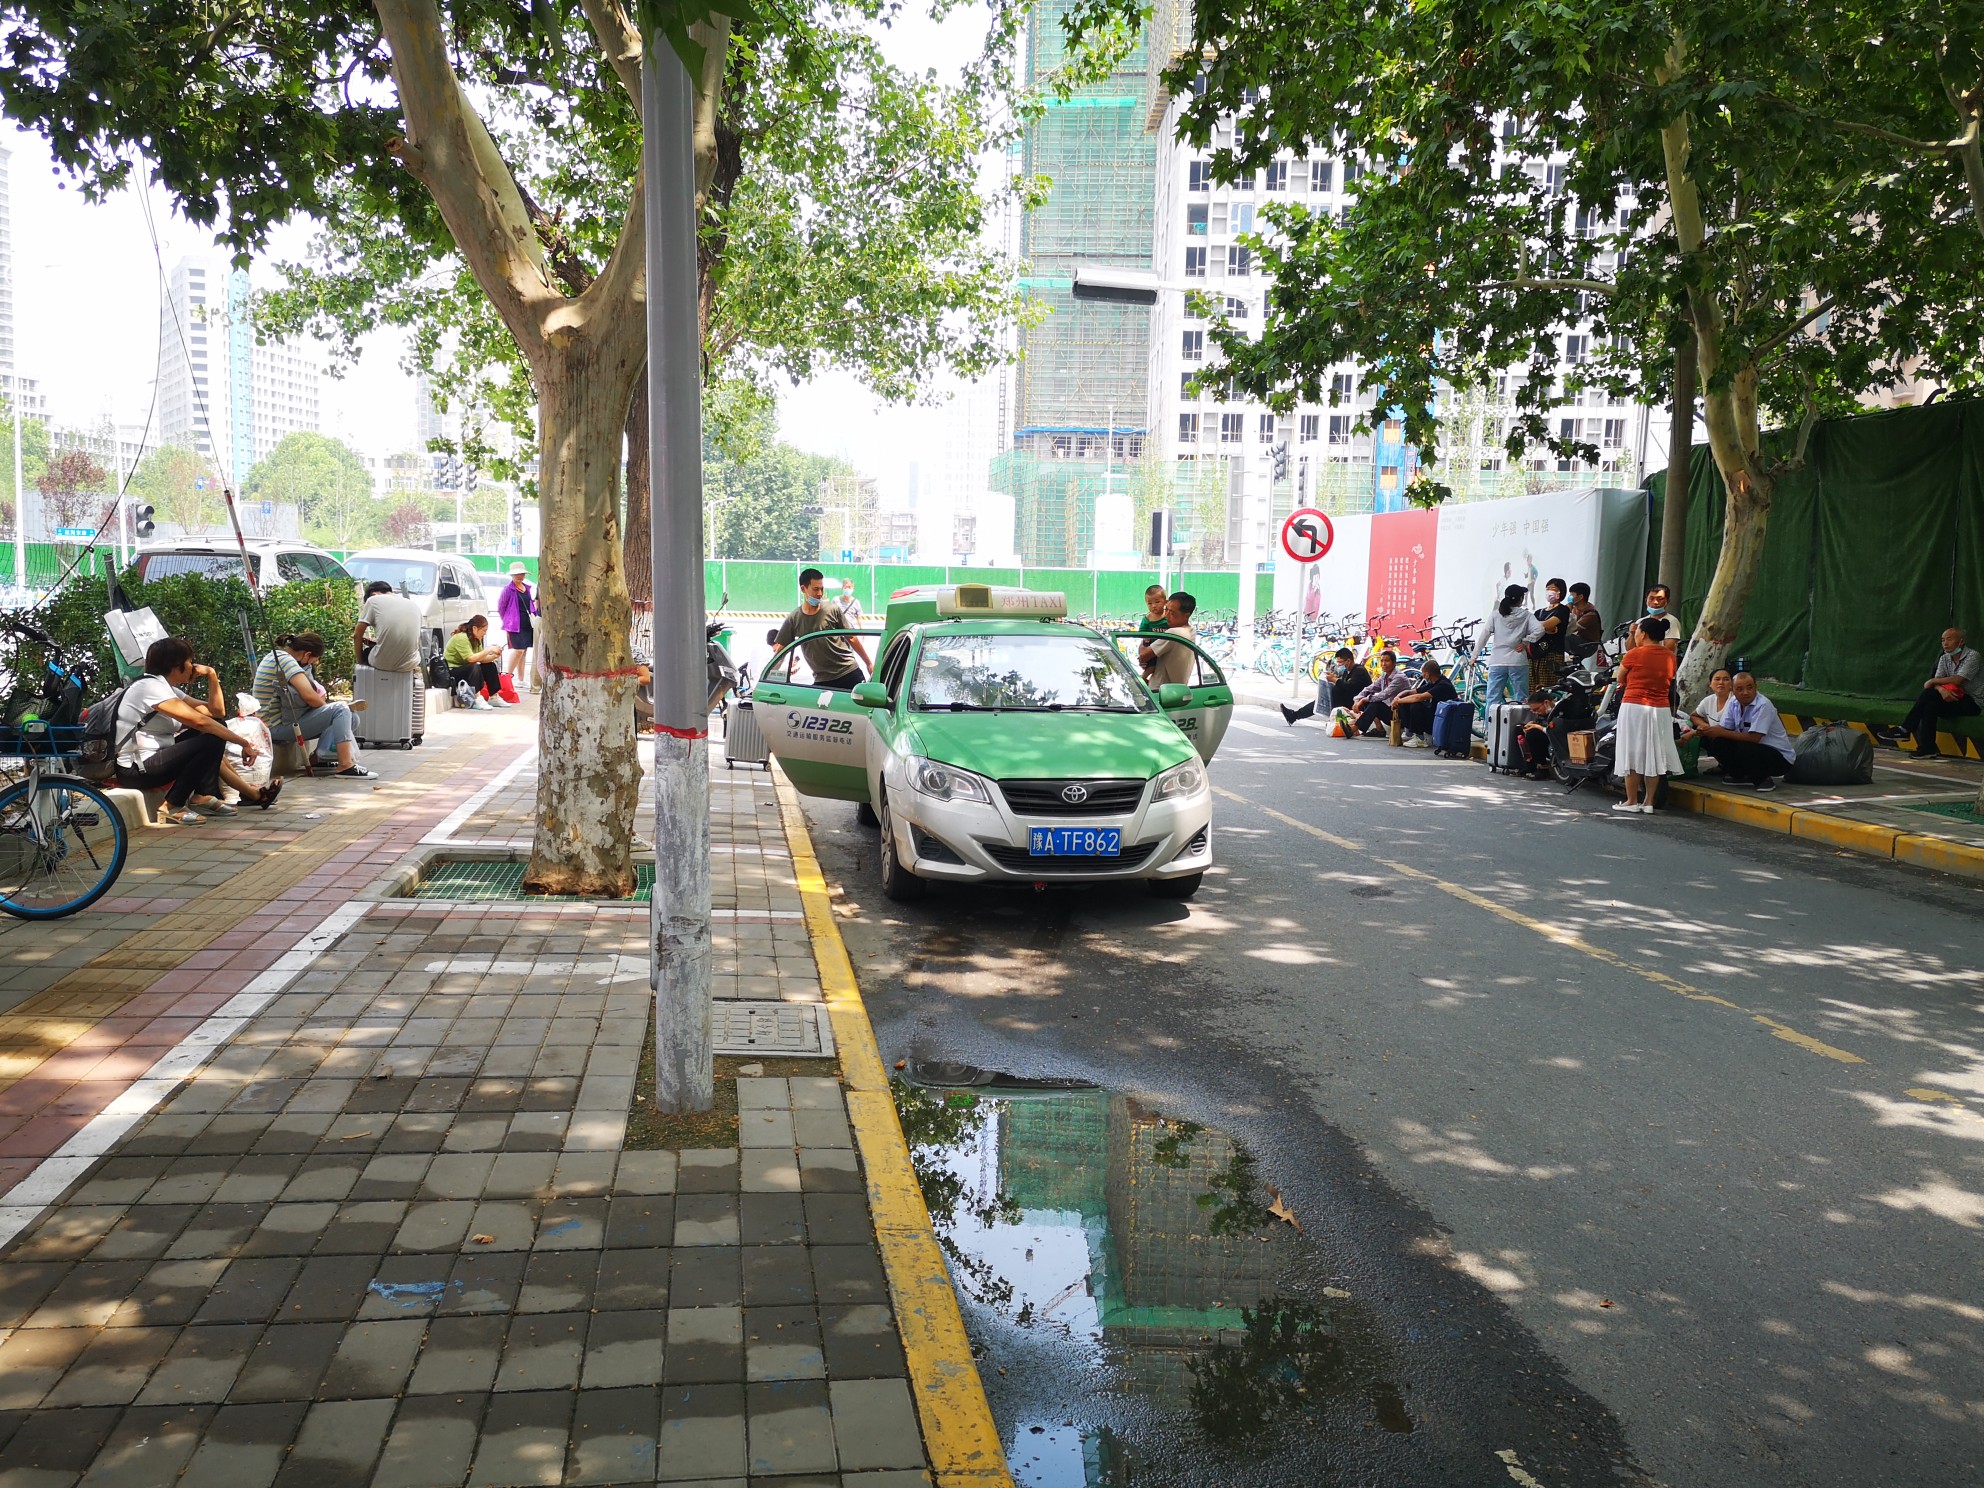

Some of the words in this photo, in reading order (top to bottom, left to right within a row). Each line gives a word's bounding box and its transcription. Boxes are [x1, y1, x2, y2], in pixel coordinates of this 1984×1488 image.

[1492, 520, 1517, 538] 少年强
[1523, 518, 1549, 536] 中国强
